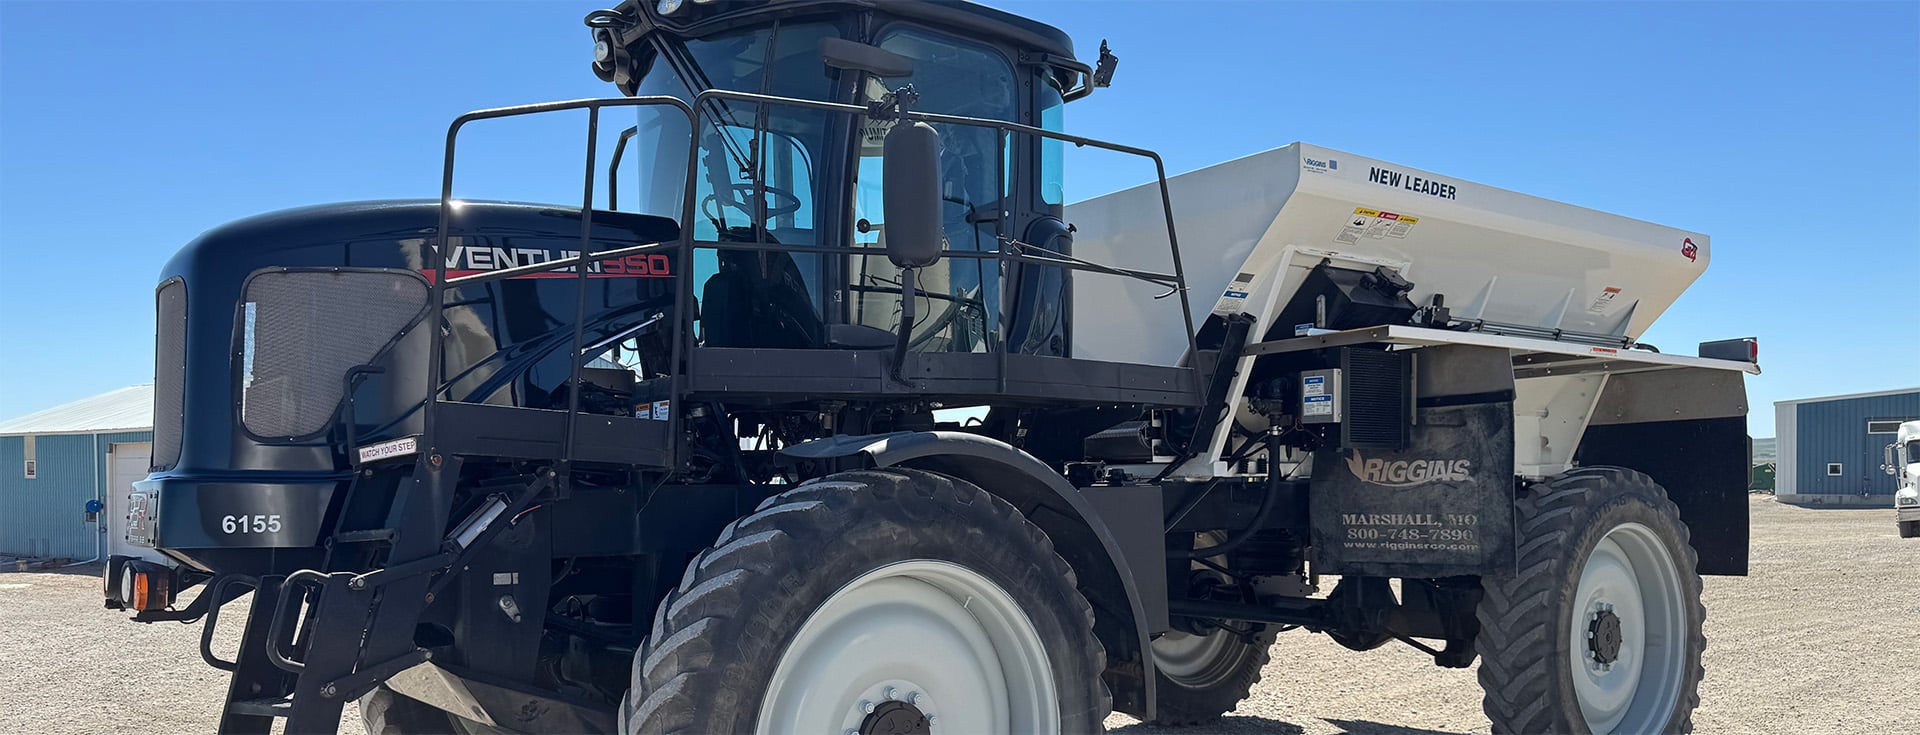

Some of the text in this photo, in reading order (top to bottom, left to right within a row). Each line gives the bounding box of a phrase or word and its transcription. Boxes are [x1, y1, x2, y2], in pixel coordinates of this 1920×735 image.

[1368, 166, 1457, 200] NEW LEADER
[361, 440, 416, 459] WATCH YOUR STEP
[1363, 458, 1471, 482] RIGGINS
[221, 514, 282, 535] 6155
[1342, 513, 1478, 528] MARSHALL, MO
[1347, 528, 1474, 541] 800-748-7890
